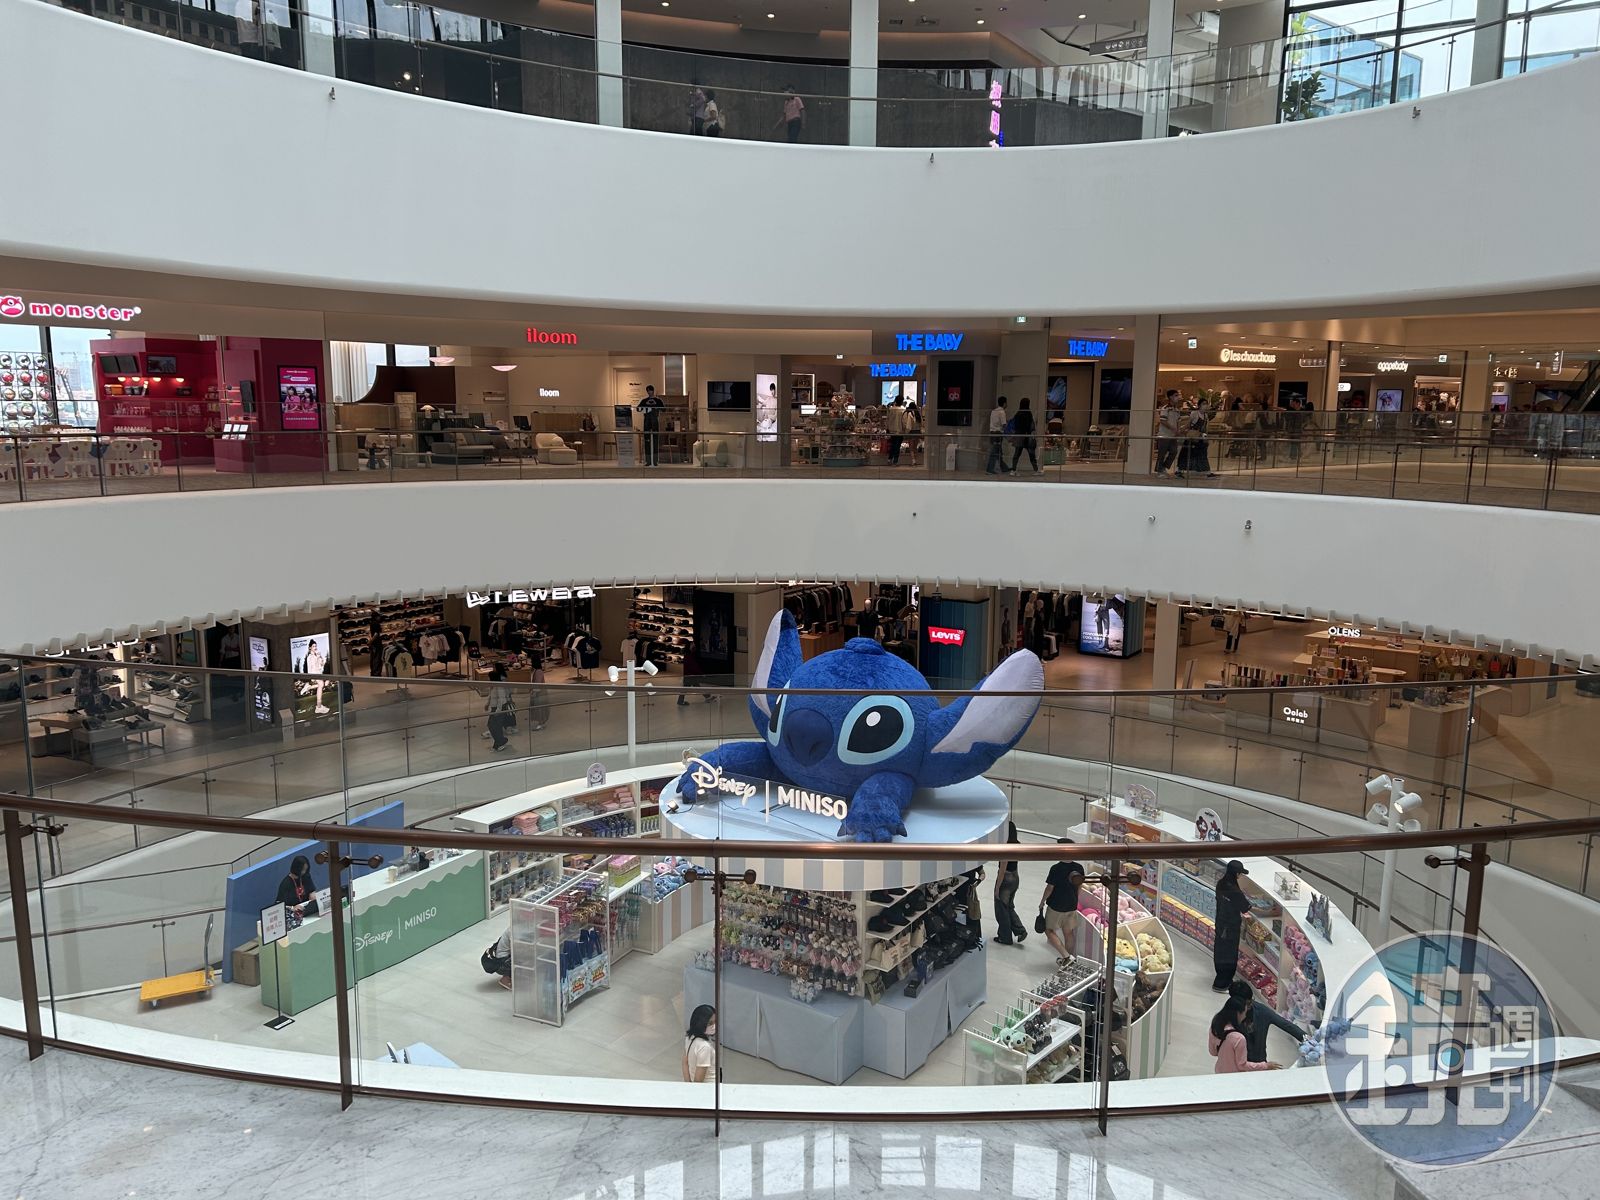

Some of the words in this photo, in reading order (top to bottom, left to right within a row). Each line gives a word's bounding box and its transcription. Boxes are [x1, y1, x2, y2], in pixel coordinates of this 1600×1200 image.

[29, 302, 135, 321] monster
[526, 327, 578, 345] iloom
[896, 333, 924, 351] THE
[924, 333, 964, 351] BABY
[1067, 340, 1085, 356] THE
[1085, 340, 1109, 357] BABY
[869, 363, 890, 377] THE
[890, 363, 917, 377] BABY
[539, 387, 560, 398] iloom
[1328, 626, 1361, 638] OLENS
[1283, 706, 1309, 719] Oolab
[777, 785, 848, 821] MINISO
[403, 906, 438, 931] MINISO
